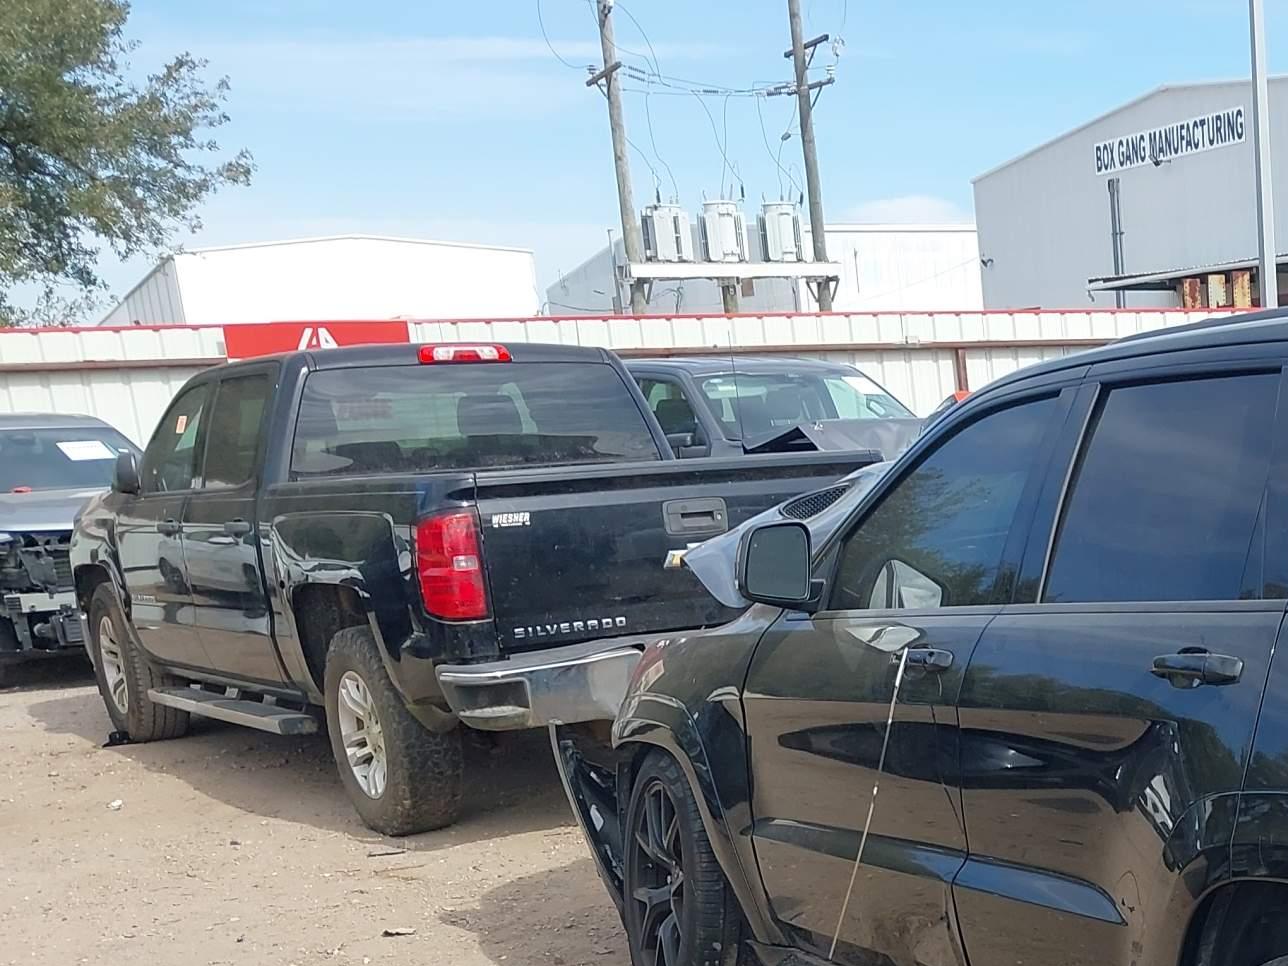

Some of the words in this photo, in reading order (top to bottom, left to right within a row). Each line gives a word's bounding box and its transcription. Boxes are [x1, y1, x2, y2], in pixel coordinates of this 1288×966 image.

[1095, 141, 1116, 173] BOX
[1117, 133, 1147, 168] GANG
[1148, 108, 1245, 159] MANUFACTURING
[513, 616, 627, 639] SILVERADO
